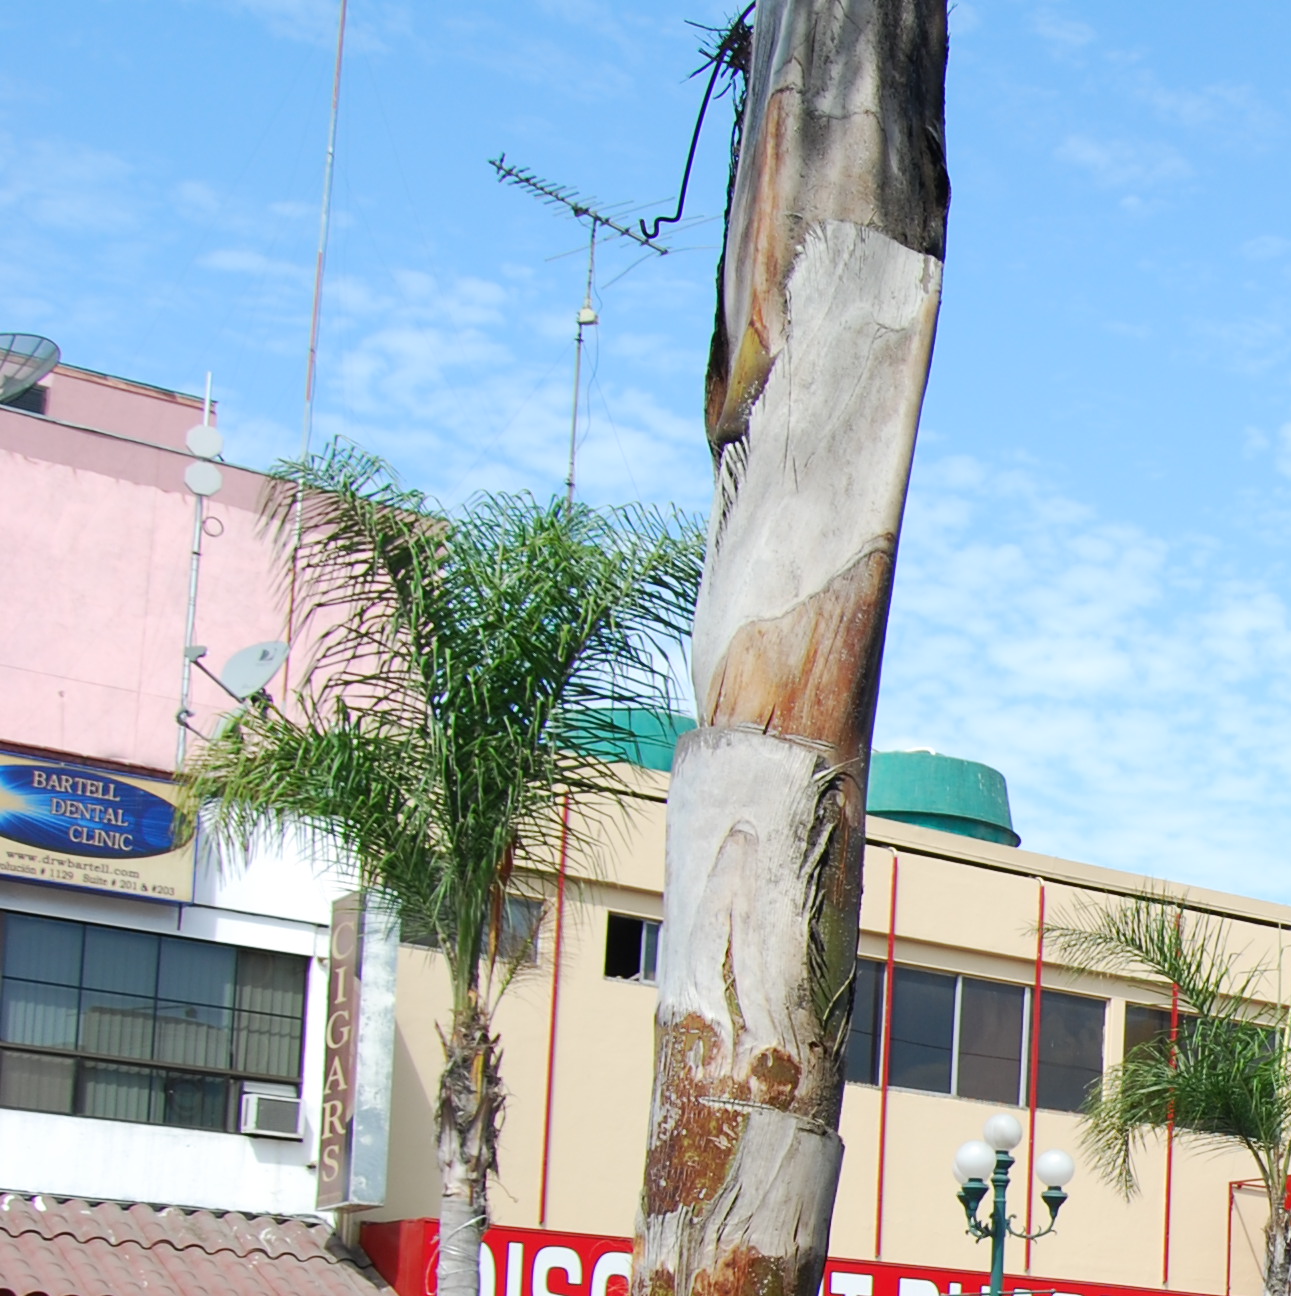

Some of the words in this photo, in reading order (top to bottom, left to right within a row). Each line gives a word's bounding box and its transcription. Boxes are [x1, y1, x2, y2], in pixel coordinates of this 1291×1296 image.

[32, 770, 121, 802] BARTELL
[51, 797, 129, 827] DENTAL
[68, 825, 133, 851] CLINIC
[6, 850, 140, 879] www.drwbartell.com
[50, 868, 74, 881] 1129
[82, 873, 109, 887] Suite
[120, 879, 138, 892] 201
[321, 920, 355, 1183] CIGARS
